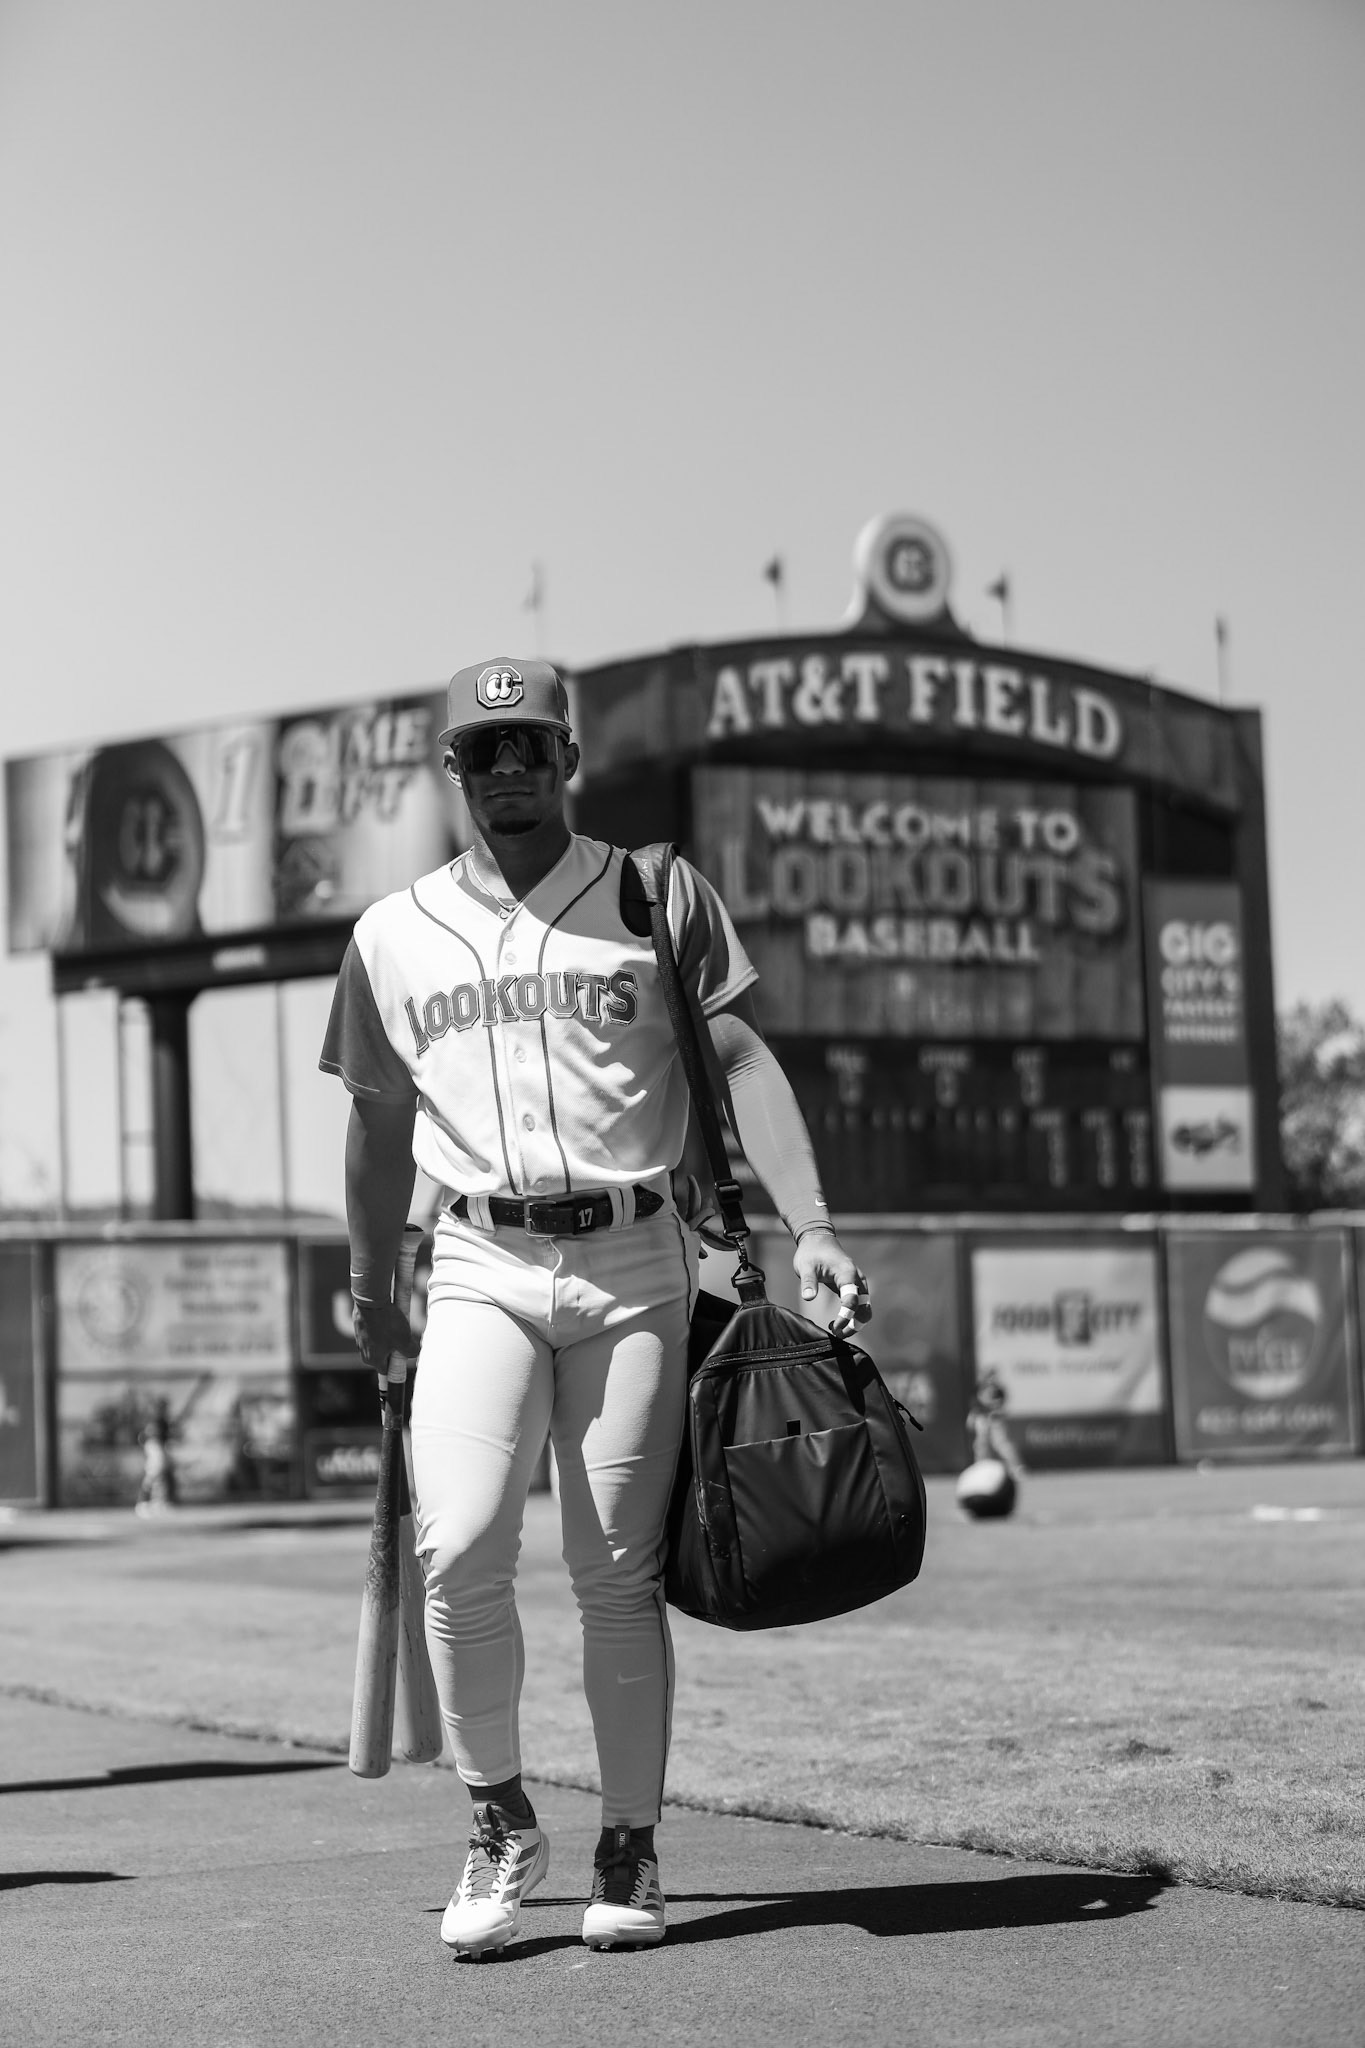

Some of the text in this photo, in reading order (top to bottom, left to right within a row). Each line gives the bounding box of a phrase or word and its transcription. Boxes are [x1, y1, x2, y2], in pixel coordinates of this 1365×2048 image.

[707, 653, 1121, 759] AT&T FIELD
[757, 800, 1080, 853] WELCOME TO
[720, 838, 1122, 934] LOOKOUTS
[807, 914, 1040, 961] BASEBALL
[404, 969, 639, 1058] LOOKOUTS
[578, 1207, 594, 1228] 17
